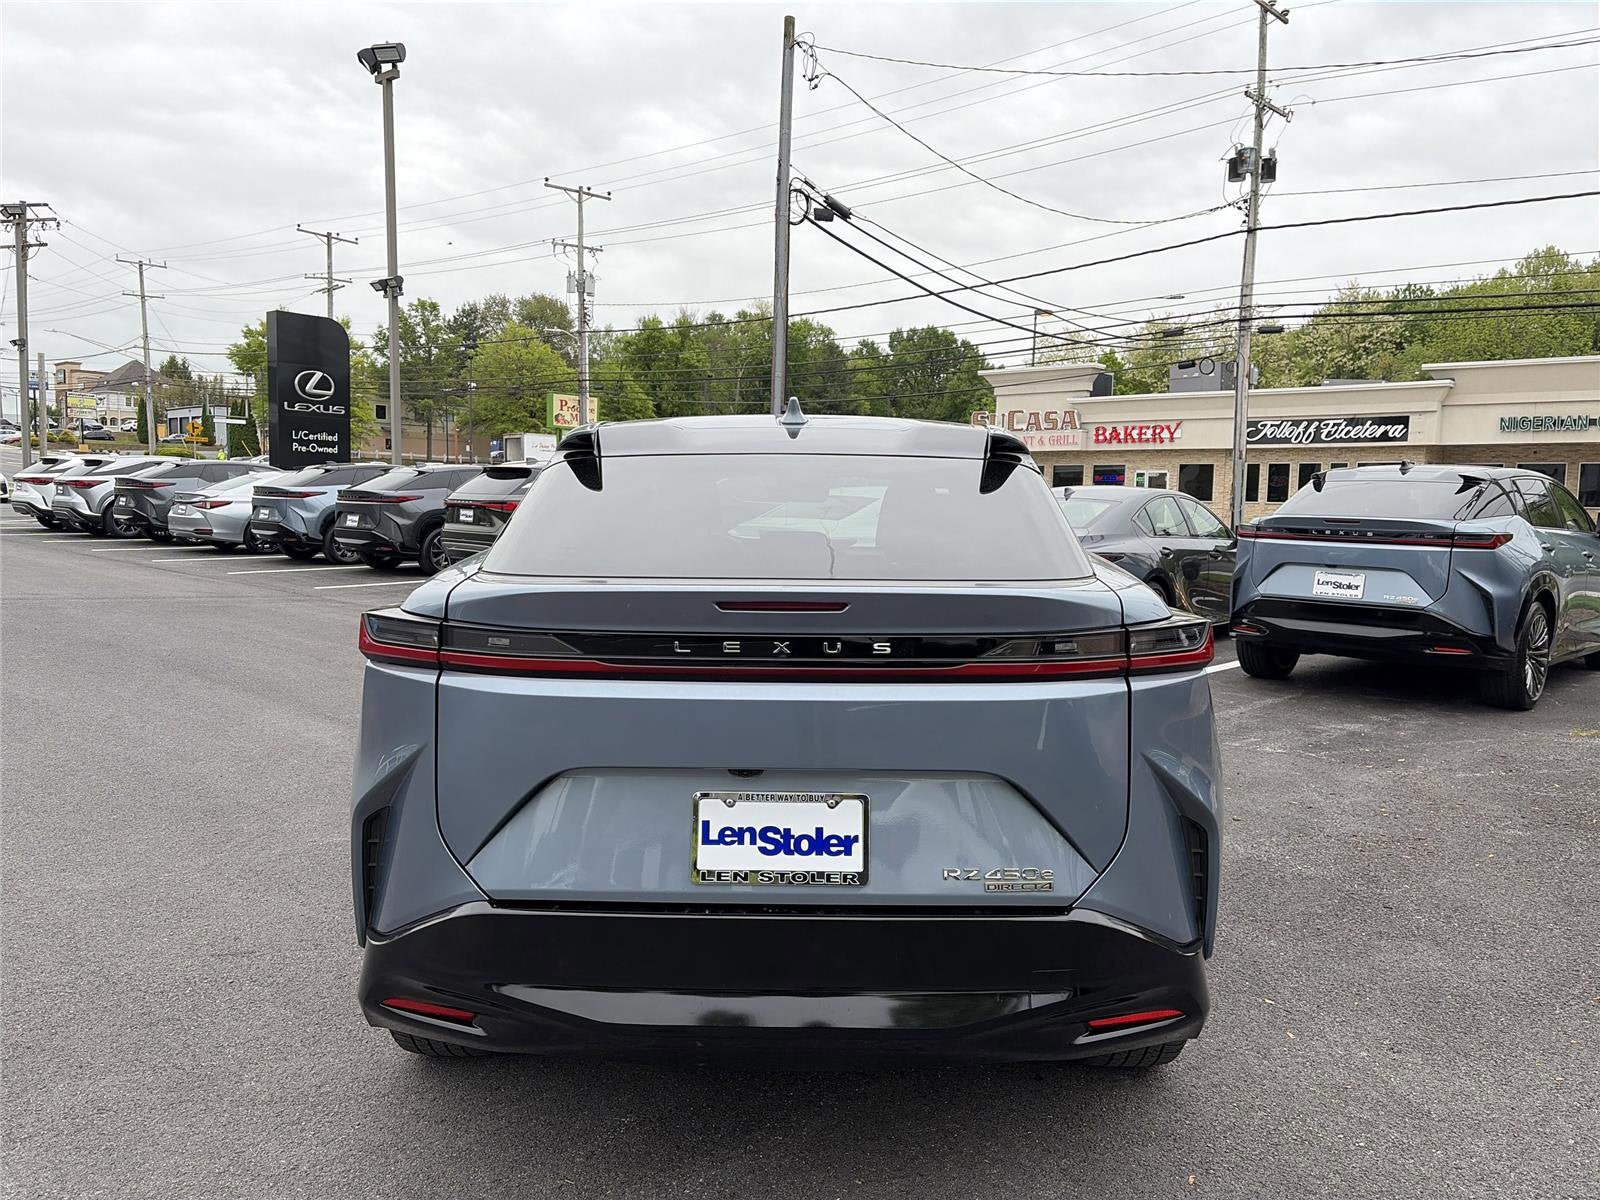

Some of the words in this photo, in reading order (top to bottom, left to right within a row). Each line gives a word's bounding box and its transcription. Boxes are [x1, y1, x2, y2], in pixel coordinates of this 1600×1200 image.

[283, 401, 346, 415] LEXUS
[1320, 418, 1407, 440] Etcetera
[1499, 415, 1590, 432] NIGERIAN
[292, 430, 338, 442] L/Certified
[1093, 420, 1183, 444] BAKERY
[1048, 434, 1079, 447] GRILL
[292, 442, 338, 454] Pre-Owned
[674, 641, 892, 654] LEXUS
[737, 793, 743, 801] A
[744, 793, 775, 801] BETTER
[777, 793, 793, 801] WAY
[796, 793, 807, 801] TO
[808, 793, 825, 801] BUY
[700, 871, 749, 882] LEN
[758, 872, 859, 884] STOLER
